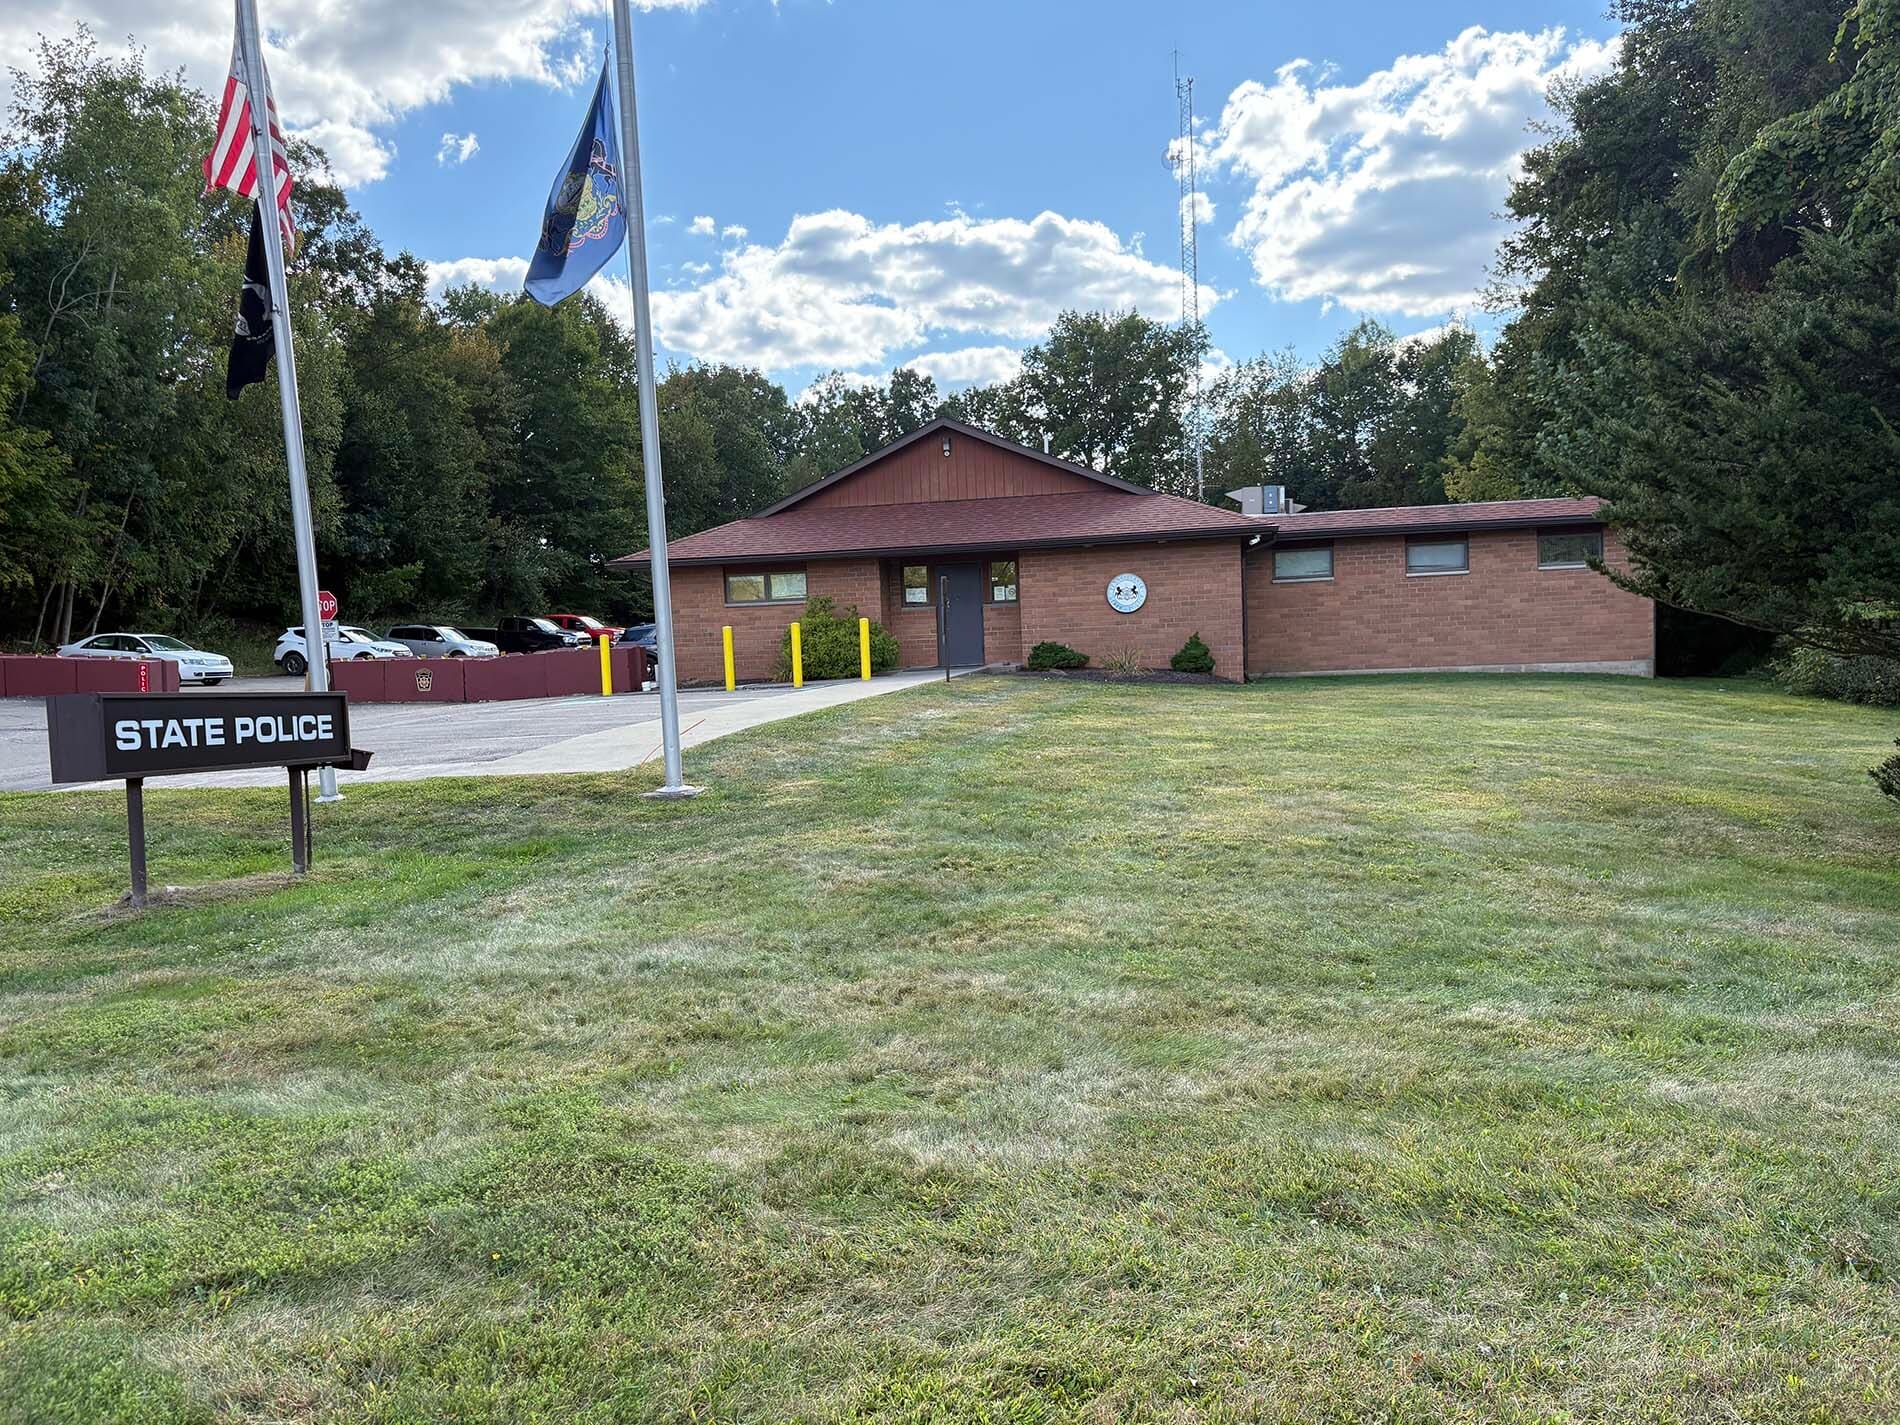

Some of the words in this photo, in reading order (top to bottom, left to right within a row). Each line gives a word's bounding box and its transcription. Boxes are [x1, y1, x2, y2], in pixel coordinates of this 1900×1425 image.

[319, 600, 335, 611] TOP
[115, 718, 225, 750] STATE
[235, 715, 334, 744] POLICE
